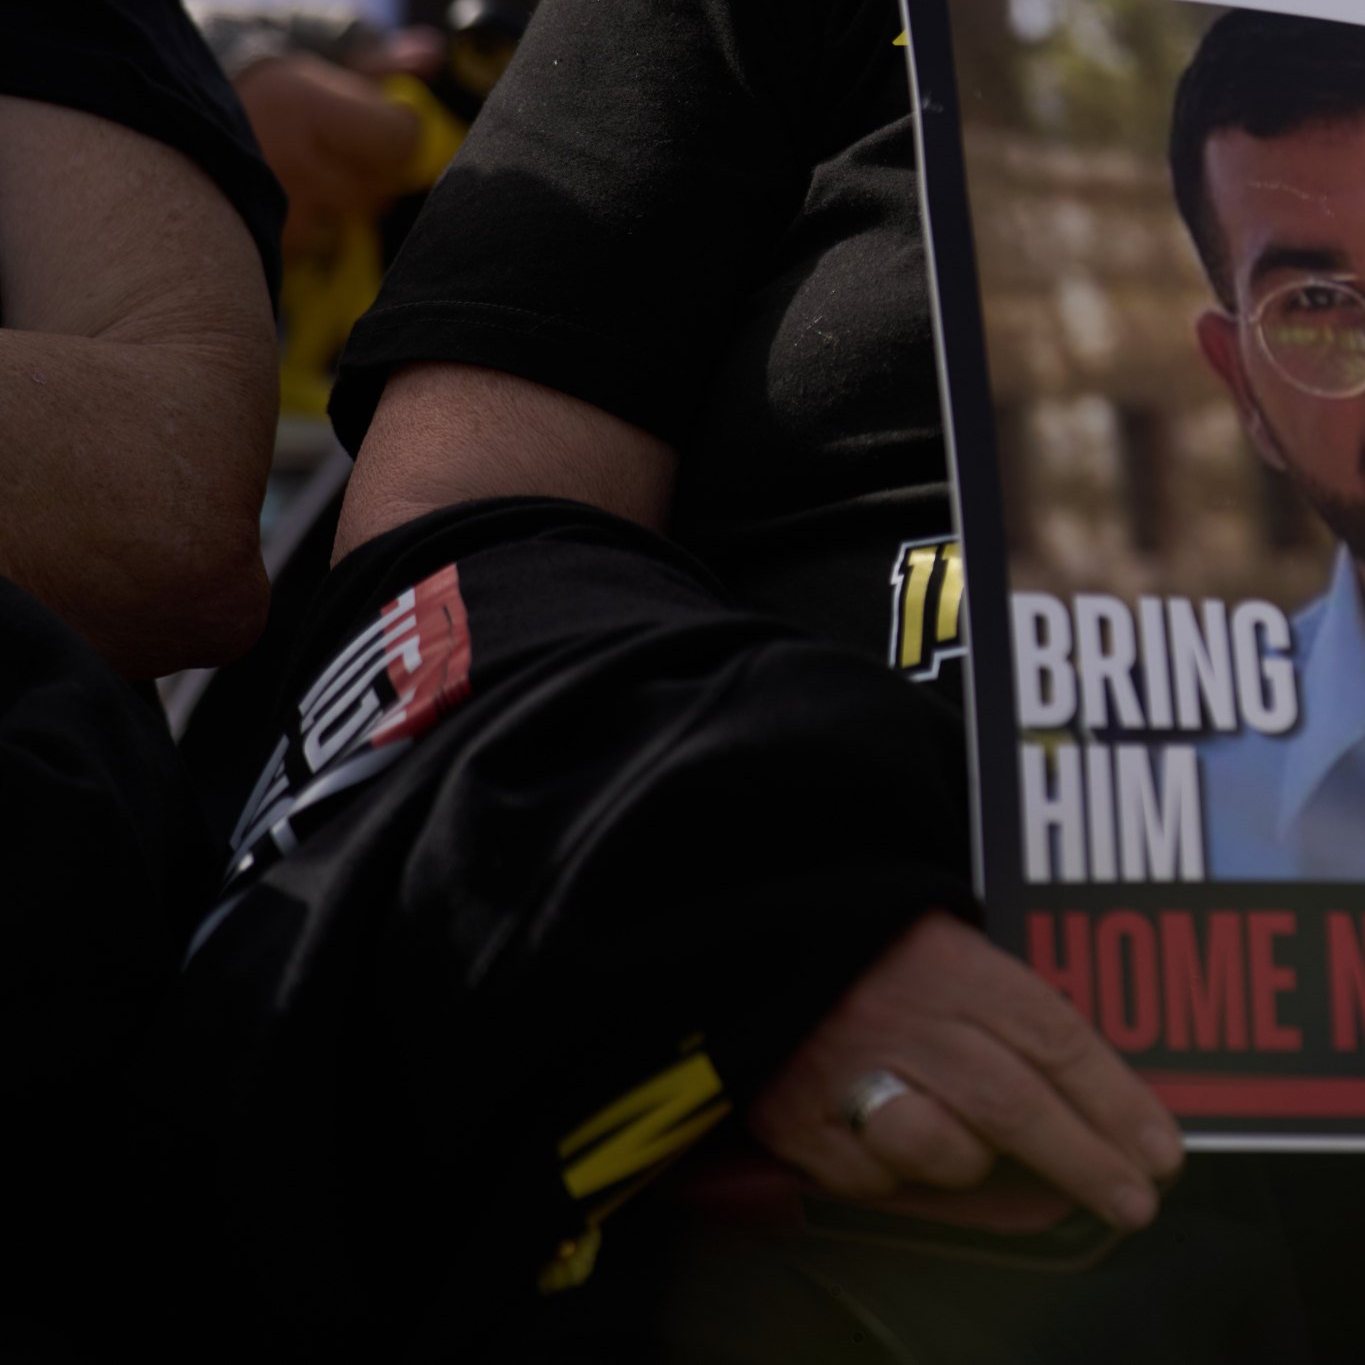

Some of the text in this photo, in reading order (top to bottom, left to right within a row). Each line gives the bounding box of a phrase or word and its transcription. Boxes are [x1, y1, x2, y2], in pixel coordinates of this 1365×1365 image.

[1007, 590, 1298, 734] BRING
[1019, 742, 1204, 883] HIM
[1024, 909, 1302, 1054] HOME
